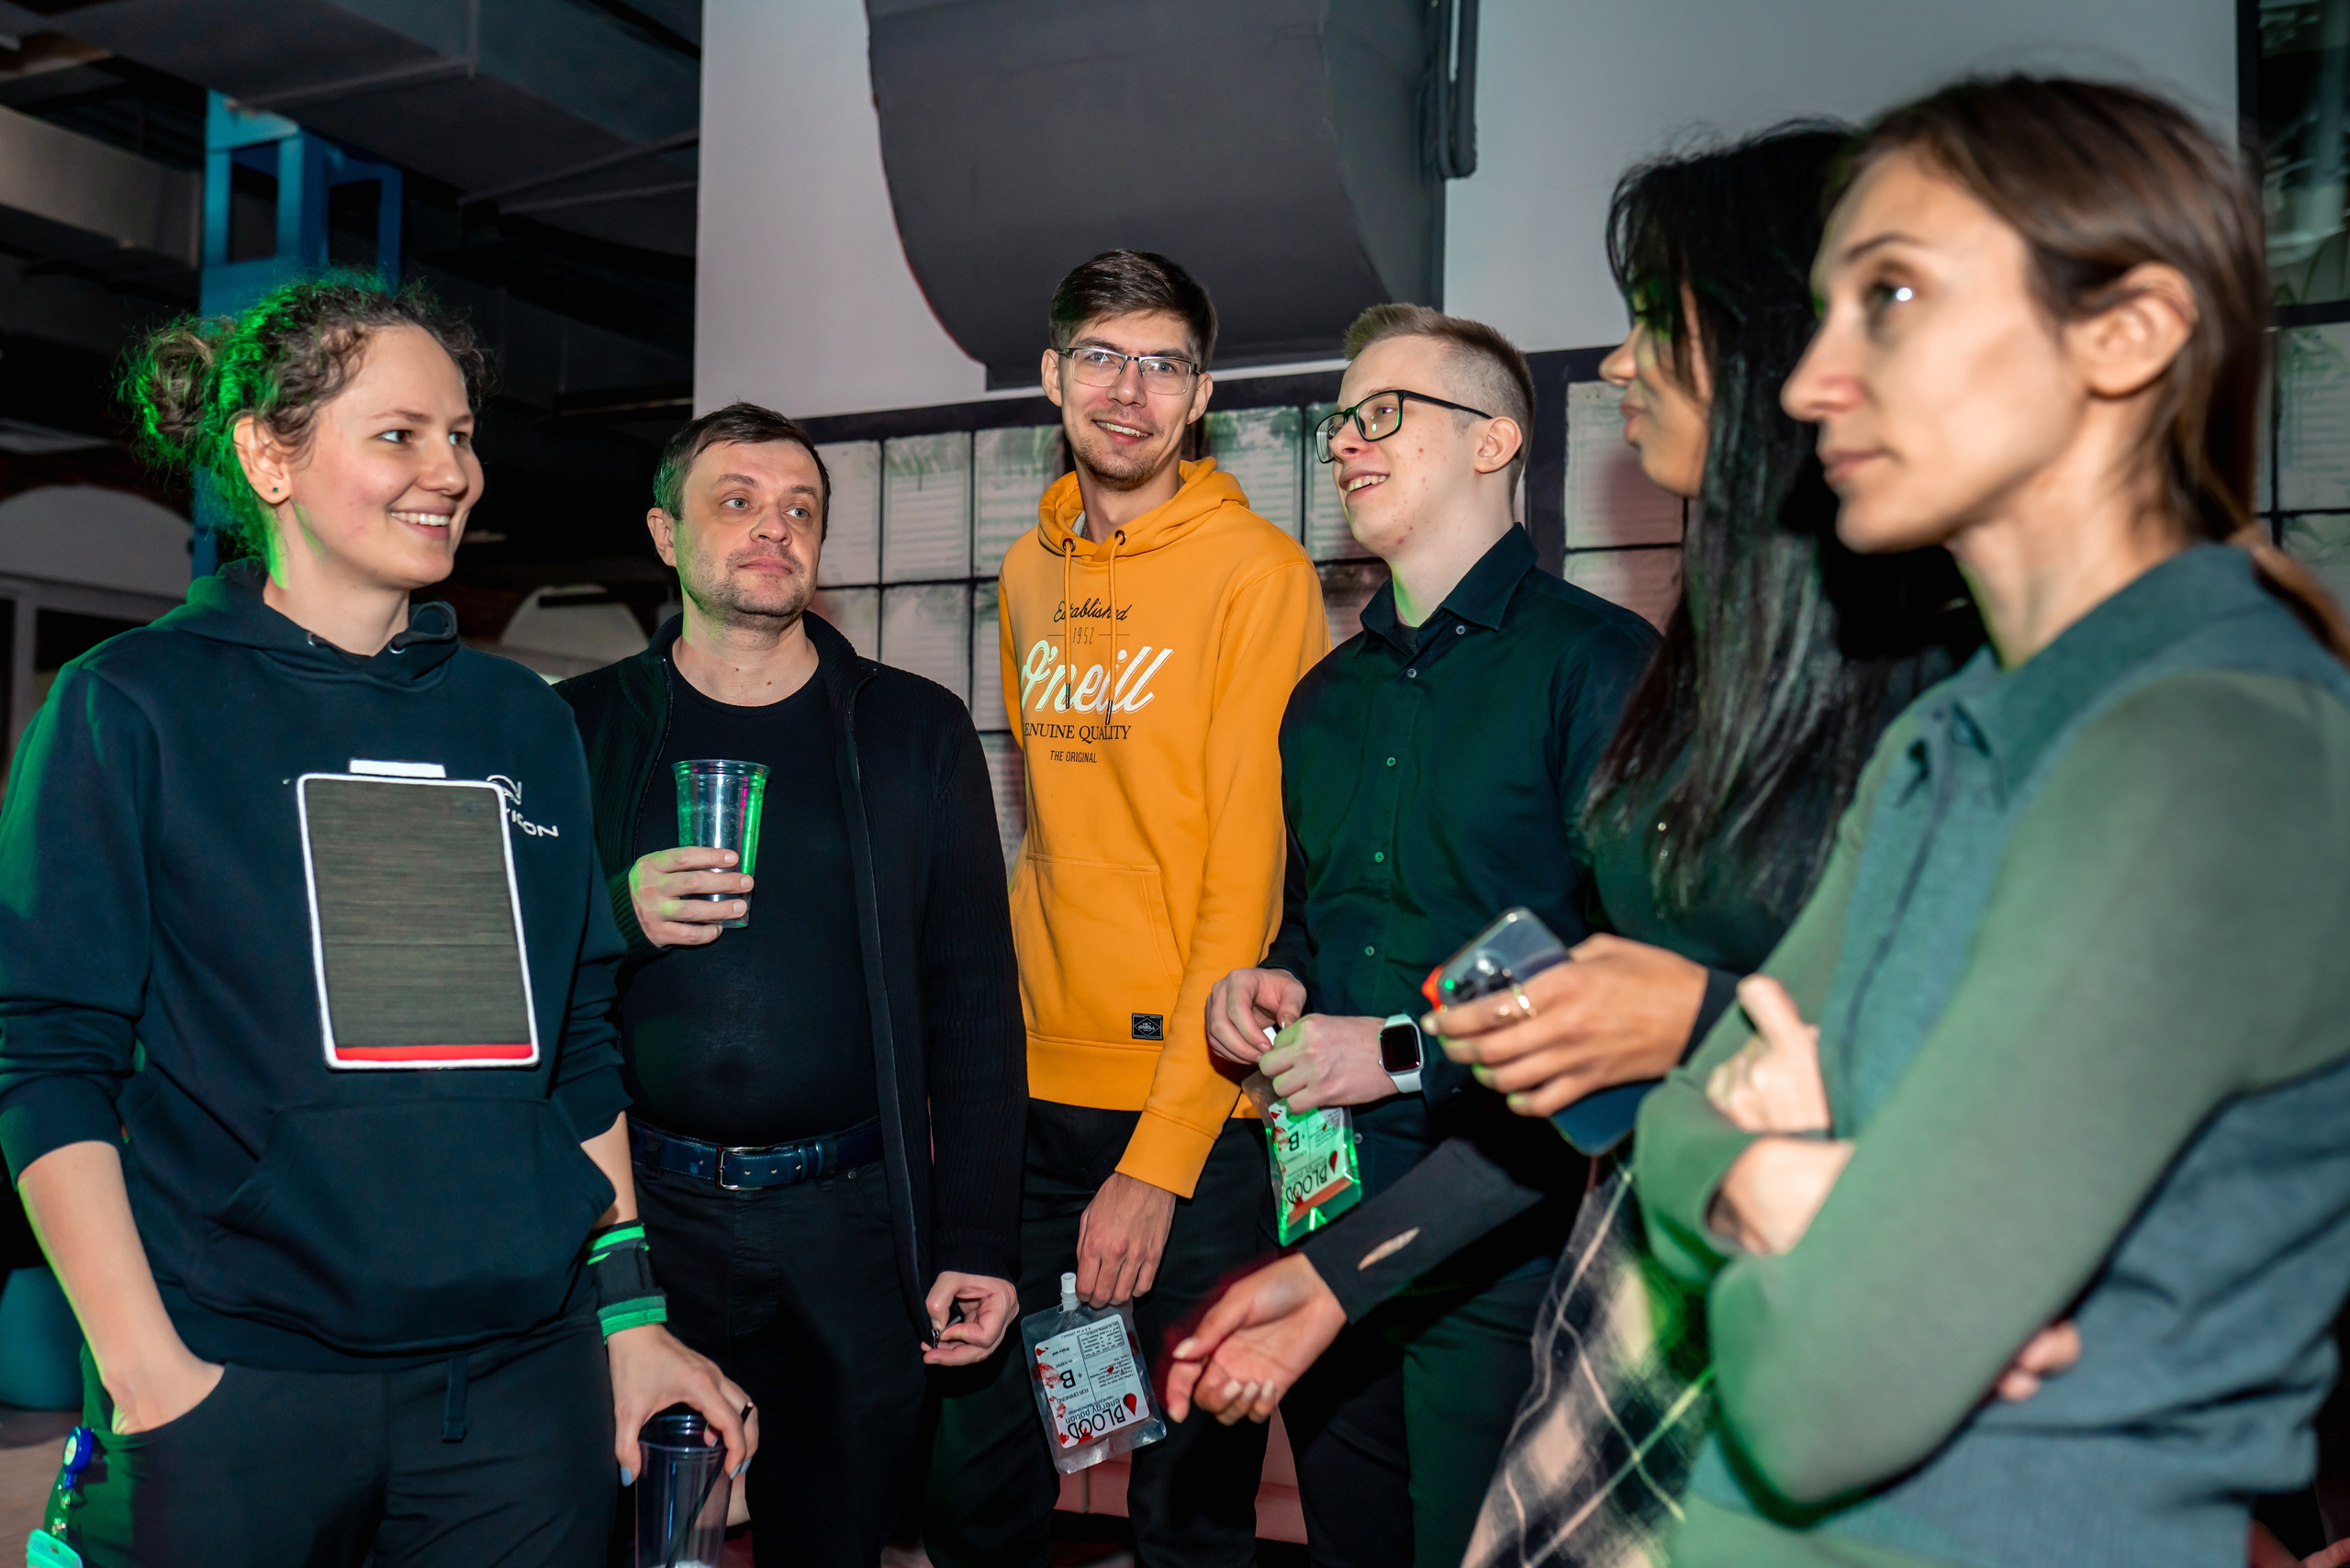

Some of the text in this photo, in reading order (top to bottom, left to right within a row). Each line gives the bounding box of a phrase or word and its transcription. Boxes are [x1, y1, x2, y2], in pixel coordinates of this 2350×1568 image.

[1053, 597, 1133, 622] Establishd
[1072, 626, 1095, 644] 1952
[1024, 722, 1132, 745] ENUINE QUALITY
[1050, 750, 1098, 763] THE ORIGINAL
[1285, 1164, 1327, 1204] BLOOD
[1059, 1369, 1076, 1389] B
[1057, 1387, 1089, 1405] FOR DRINKING
[1065, 1398, 1121, 1424] energy potion
[1068, 1404, 1126, 1439] BLOOD
